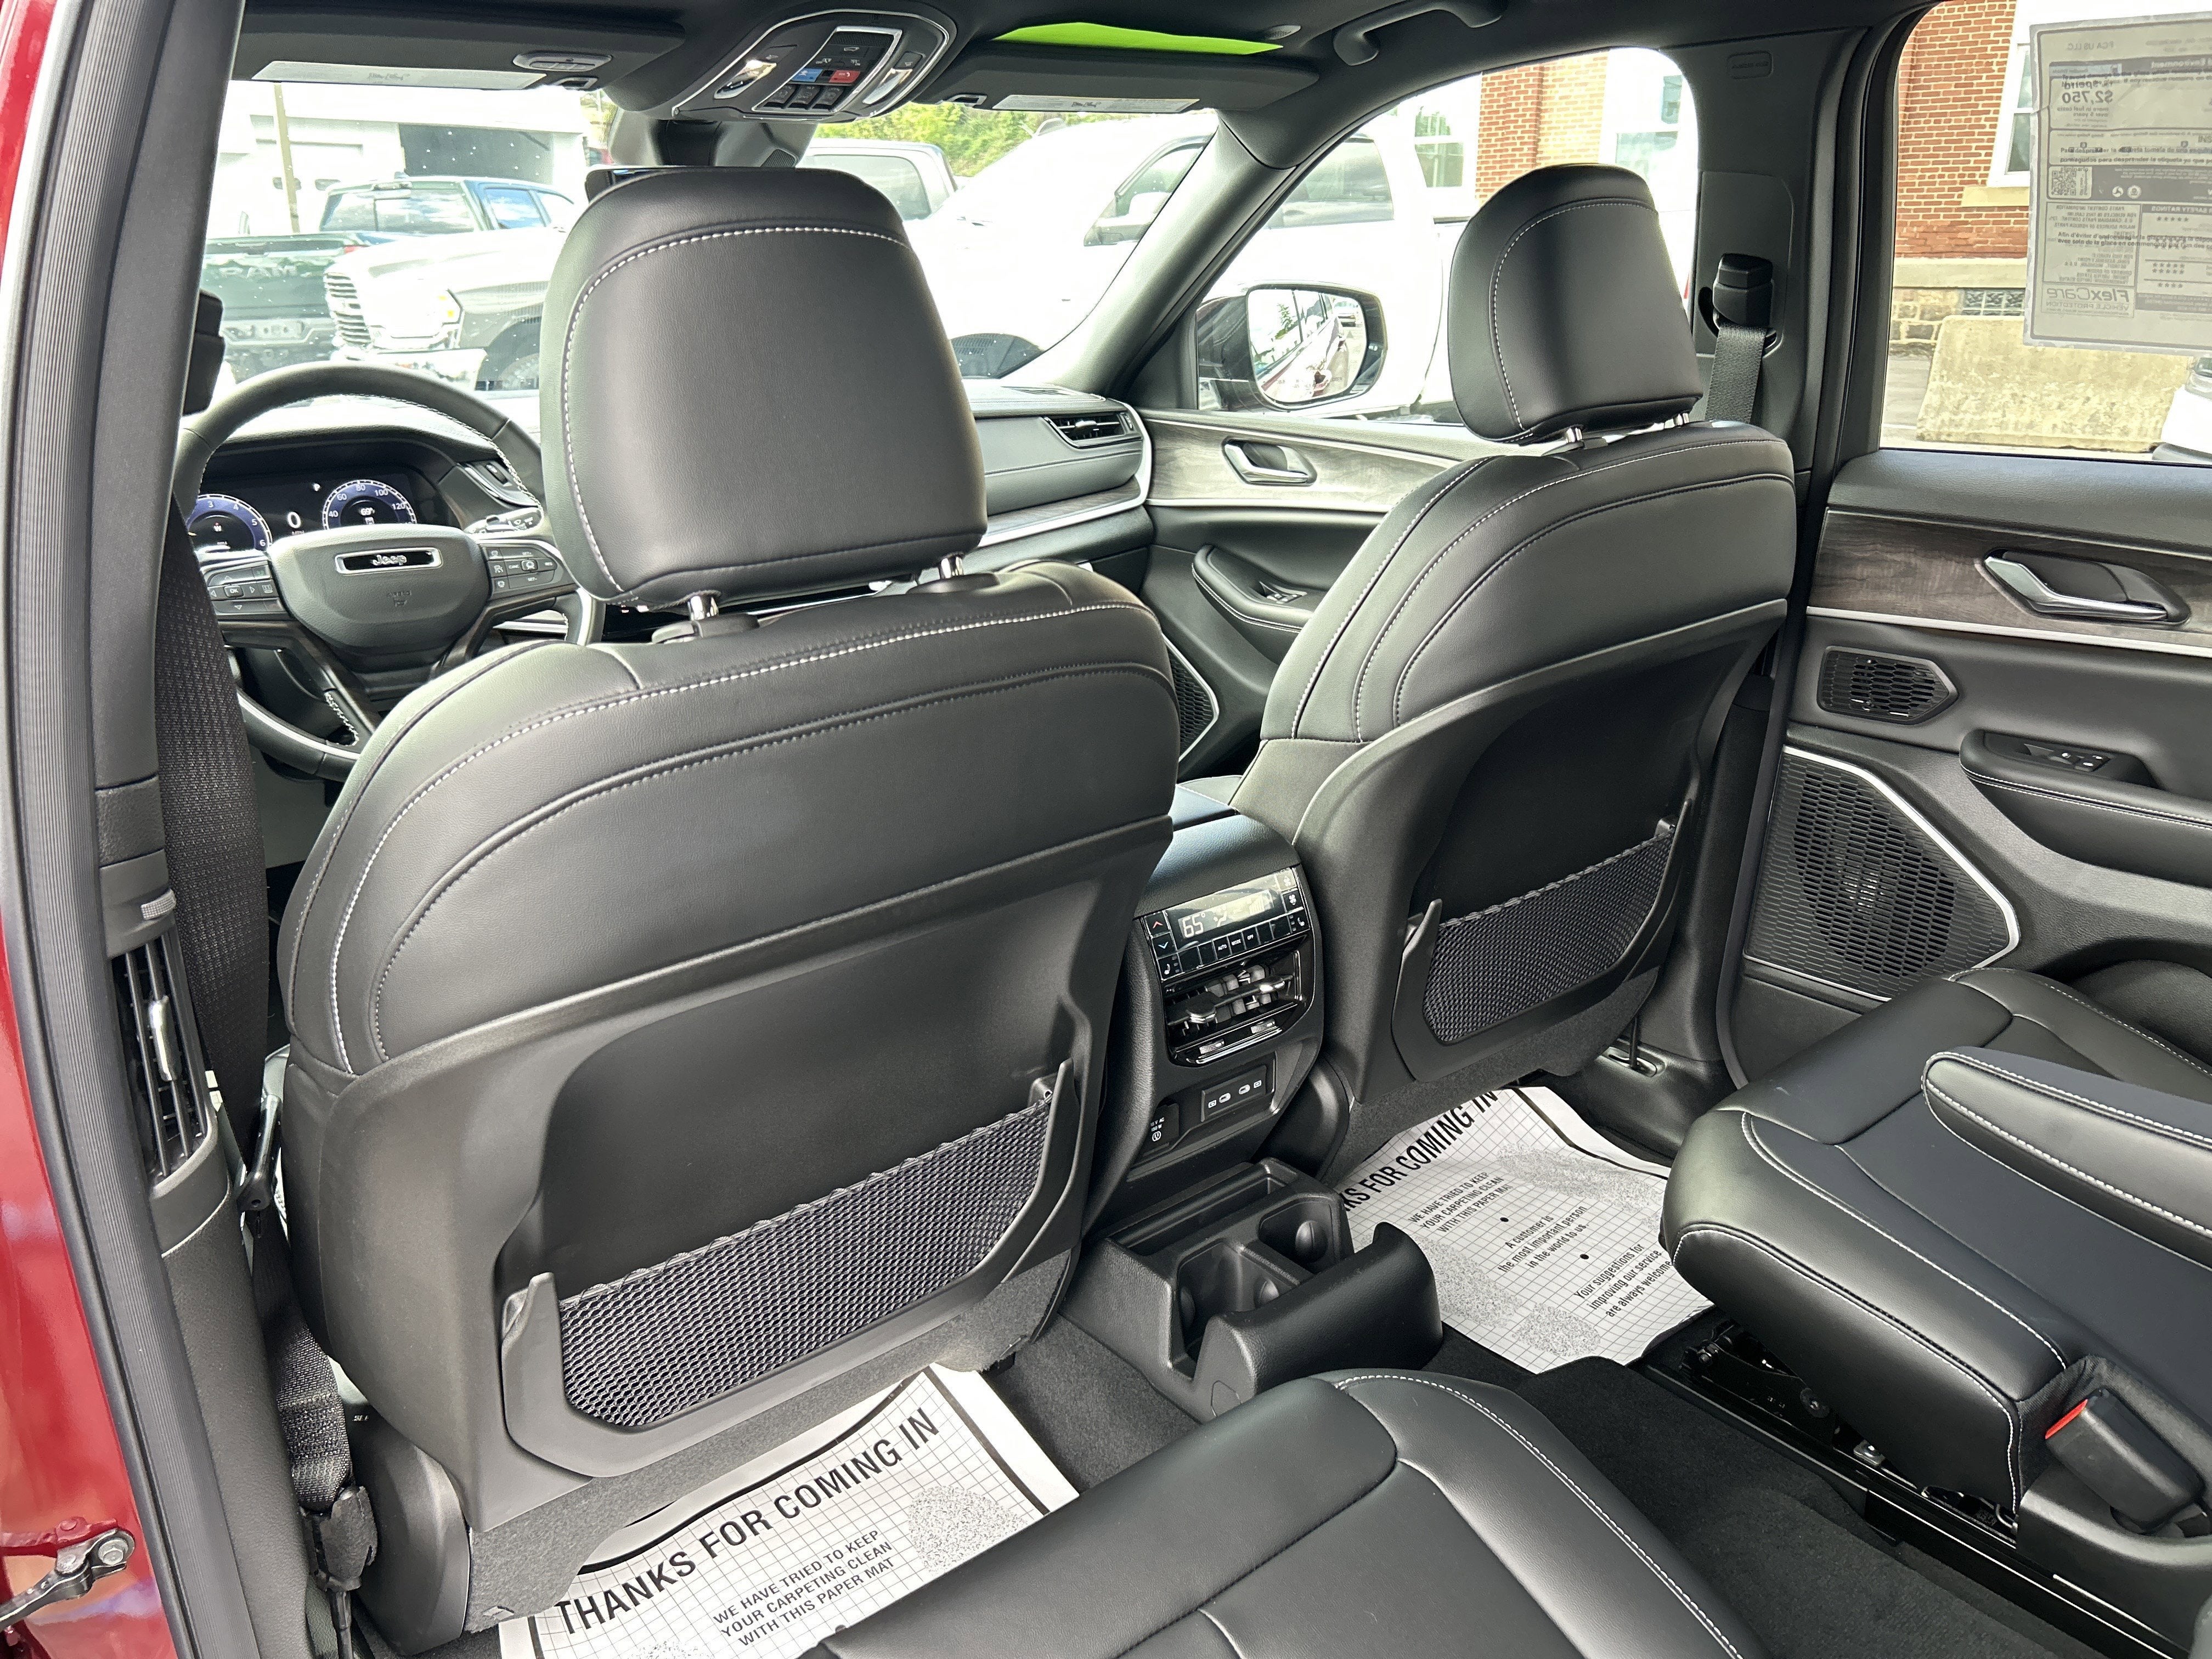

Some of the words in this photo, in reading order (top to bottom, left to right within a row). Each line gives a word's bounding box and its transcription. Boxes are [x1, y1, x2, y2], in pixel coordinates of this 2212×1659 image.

[287, 511, 301, 529] 0
[371, 554, 407, 566] Jeep
[1358, 1166, 1408, 1193] FOR
[1396, 1105, 1475, 1170] COMING
[1408, 1212, 1425, 1223] WE
[1421, 1200, 1443, 1215] HAVE
[1439, 1188, 1464, 1203] TRIED
[1459, 1182, 1474, 1190] TO
[1469, 1172, 1489, 1184] KEEP
[1420, 1214, 1446, 1229] YOUR
[1441, 1189, 1482, 1216] CARPETING
[1478, 1176, 1505, 1191] CLEAN
[1437, 1218, 1459, 1233] WITH
[1456, 1206, 1478, 1220] THIS
[1473, 1192, 1500, 1209] PAPER
[1494, 1183, 1514, 1195] MAT
[1497, 1261, 1515, 1272] the
[1512, 1245, 1533, 1263] most
[1529, 1223, 1566, 1249] important
[1561, 1205, 1588, 1226] person
[1505, 1241, 1517, 1249] A
[1513, 1220, 1547, 1244] customer
[1525, 1260, 1539, 1268] in
[1533, 1250, 1551, 1262] the
[1547, 1235, 1570, 1252] world
[1574, 1223, 1589, 1233] us.
[1573, 1284, 1595, 1299] Your
[1592, 1251, 1635, 1286] suggestions
[1629, 1243, 1645, 1254] for
[1587, 1279, 1629, 1310] improving
[1623, 1268, 1639, 1282] our
[1634, 1250, 1662, 1272] service
[1605, 1305, 1622, 1317] are
[1618, 1284, 1645, 1308] always
[554, 1551, 696, 1634] THANKS
[699, 1510, 774, 1559] FOR
[774, 1439, 903, 1519] COMING
[899, 1408, 940, 1450] IN
[713, 1605, 740, 1623] WE
[740, 1583, 780, 1609] HAVE
[779, 1561, 823, 1588] TRIED
[823, 1549, 844, 1564] TO
[845, 1530, 879, 1554] KEEP
[721, 1610, 765, 1638] YOUR
[766, 1566, 847, 1613] CARPETING
[847, 1542, 893, 1570] CLEAN
[738, 1619, 780, 1646] WITH
[780, 1600, 815, 1623] THIS
[816, 1575, 864, 1604] PAPER
[864, 1557, 895, 1579] MAT
